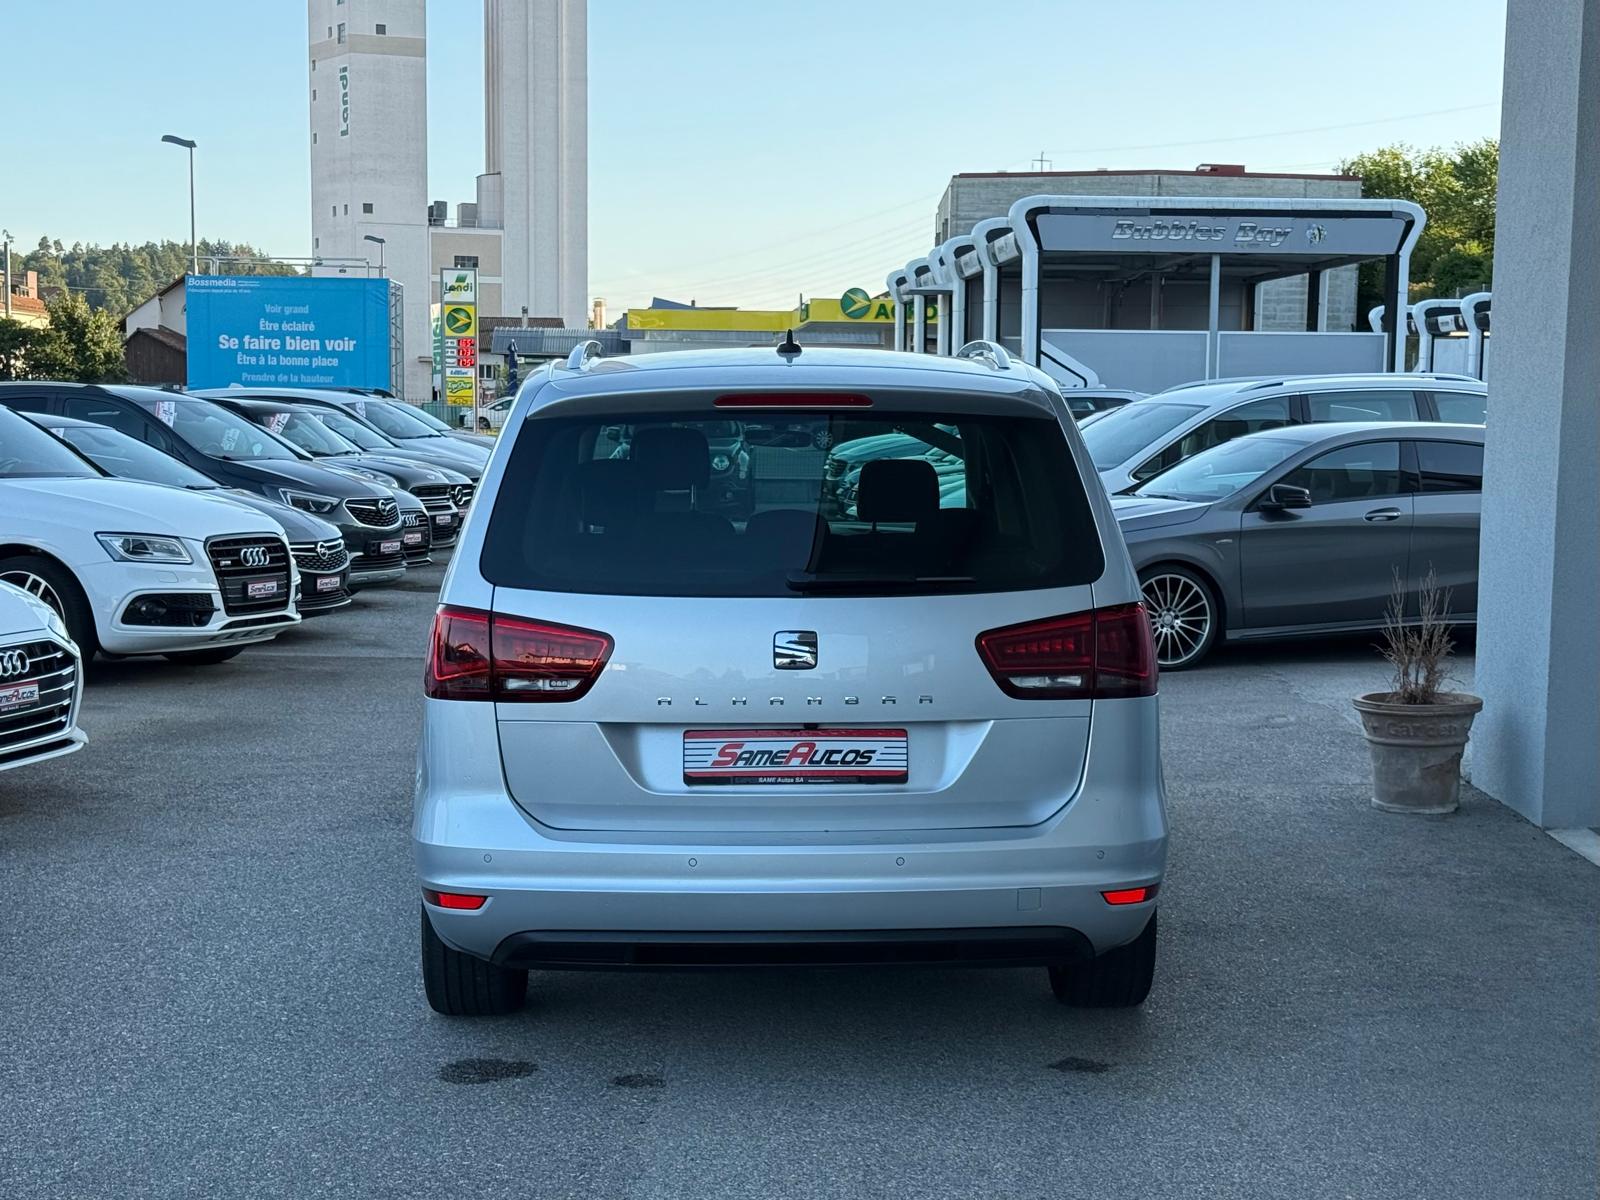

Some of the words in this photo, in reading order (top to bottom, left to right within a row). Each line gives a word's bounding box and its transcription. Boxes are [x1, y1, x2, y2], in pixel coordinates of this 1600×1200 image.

[339, 65, 349, 136] Landi
[1112, 219, 1226, 241] Bubbles
[1234, 222, 1293, 247] Bay
[188, 277, 237, 287] Bossmedia
[444, 282, 473, 293] Landi
[264, 304, 281, 314] Voir
[284, 304, 309, 315] grand
[259, 318, 279, 331] Être
[282, 319, 315, 332] éclairé
[219, 334, 239, 349] Se
[243, 335, 280, 350] faire
[286, 336, 320, 351] bien
[325, 338, 356, 351] voir
[237, 352, 257, 365] Être
[258, 353, 265, 365] à
[268, 354, 277, 365] la
[280, 354, 310, 366] bonne
[312, 355, 338, 368] place
[242, 372, 276, 382] Prendre
[277, 372, 288, 383] de
[290, 373, 299, 383] la
[301, 374, 334, 384] hauteur
[657, 695, 933, 706] ALHAMBRA
